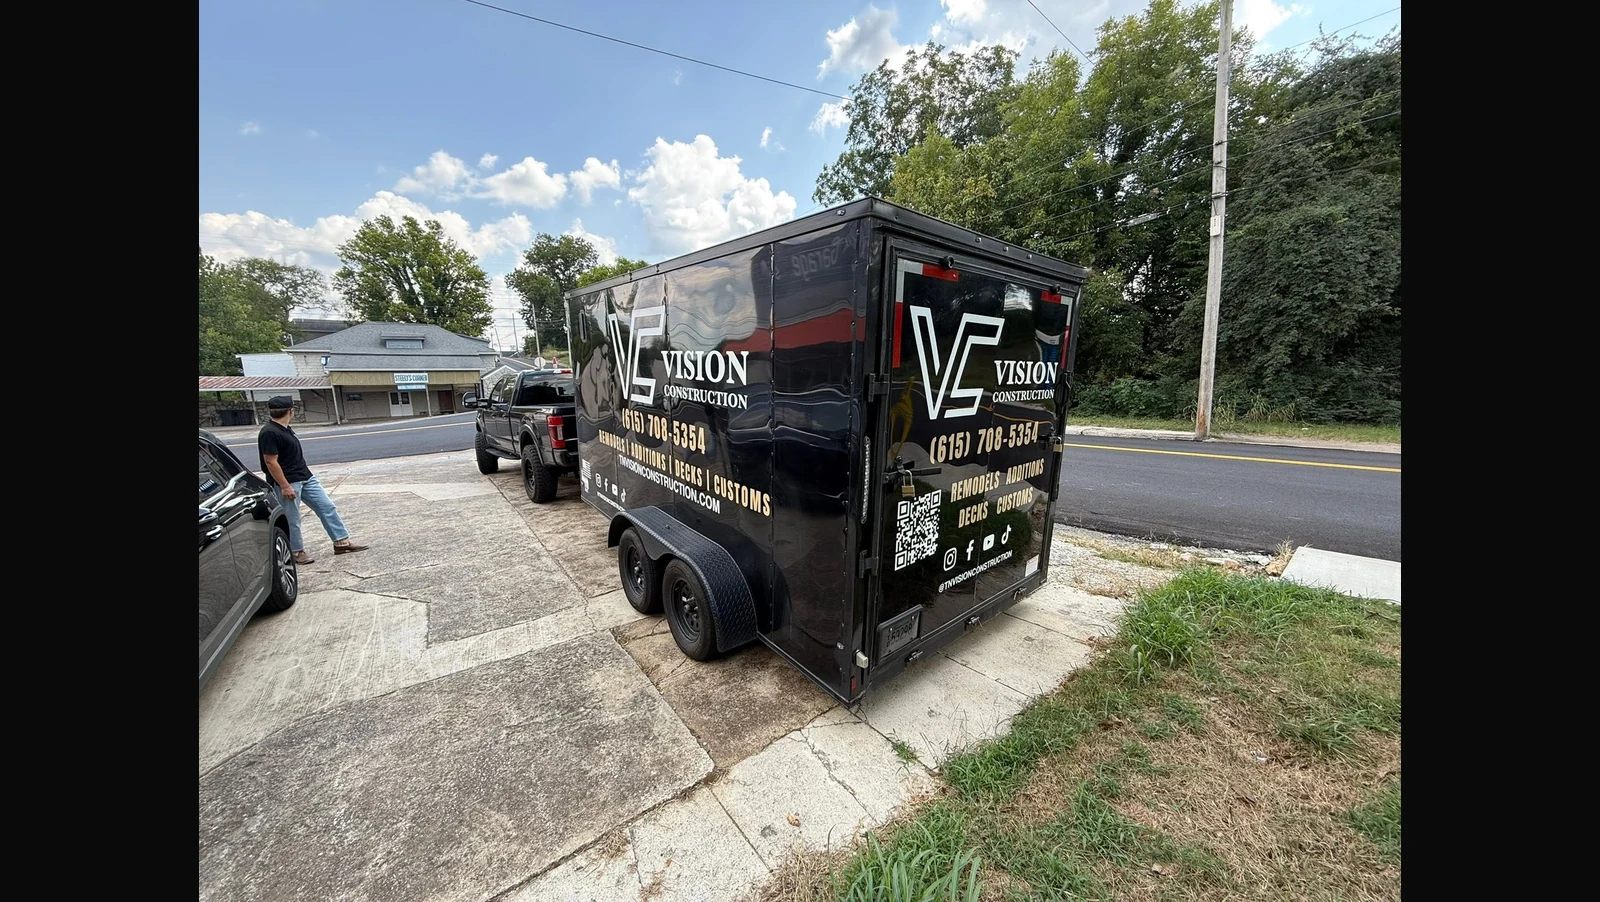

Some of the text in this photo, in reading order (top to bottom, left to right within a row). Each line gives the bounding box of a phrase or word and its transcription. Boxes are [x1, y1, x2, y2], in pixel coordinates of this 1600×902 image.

[661, 350, 749, 386] VISION
[993, 360, 1059, 386] VISION
[663, 384, 749, 410] CONSTRUCTION
[992, 388, 1056, 403] CONSTRUCTION
[621, 407, 706, 455] (615) 708-5354
[929, 421, 1040, 465] (615) 708-5354
[598, 429, 625, 453] REMODELS
[630, 442, 667, 471] ADDITIONS
[674, 459, 703, 488] DECKS
[713, 474, 771, 517] CUSTOMS
[618, 454, 721, 514] TNVISIONCONSTRUCTION.COM
[950, 458, 1045, 503] REMODELS ADDITIONS
[958, 486, 1034, 529] DECKS CUSTOMS
[938, 550, 1013, 593] @TNVISIONCONSTRUCTION
